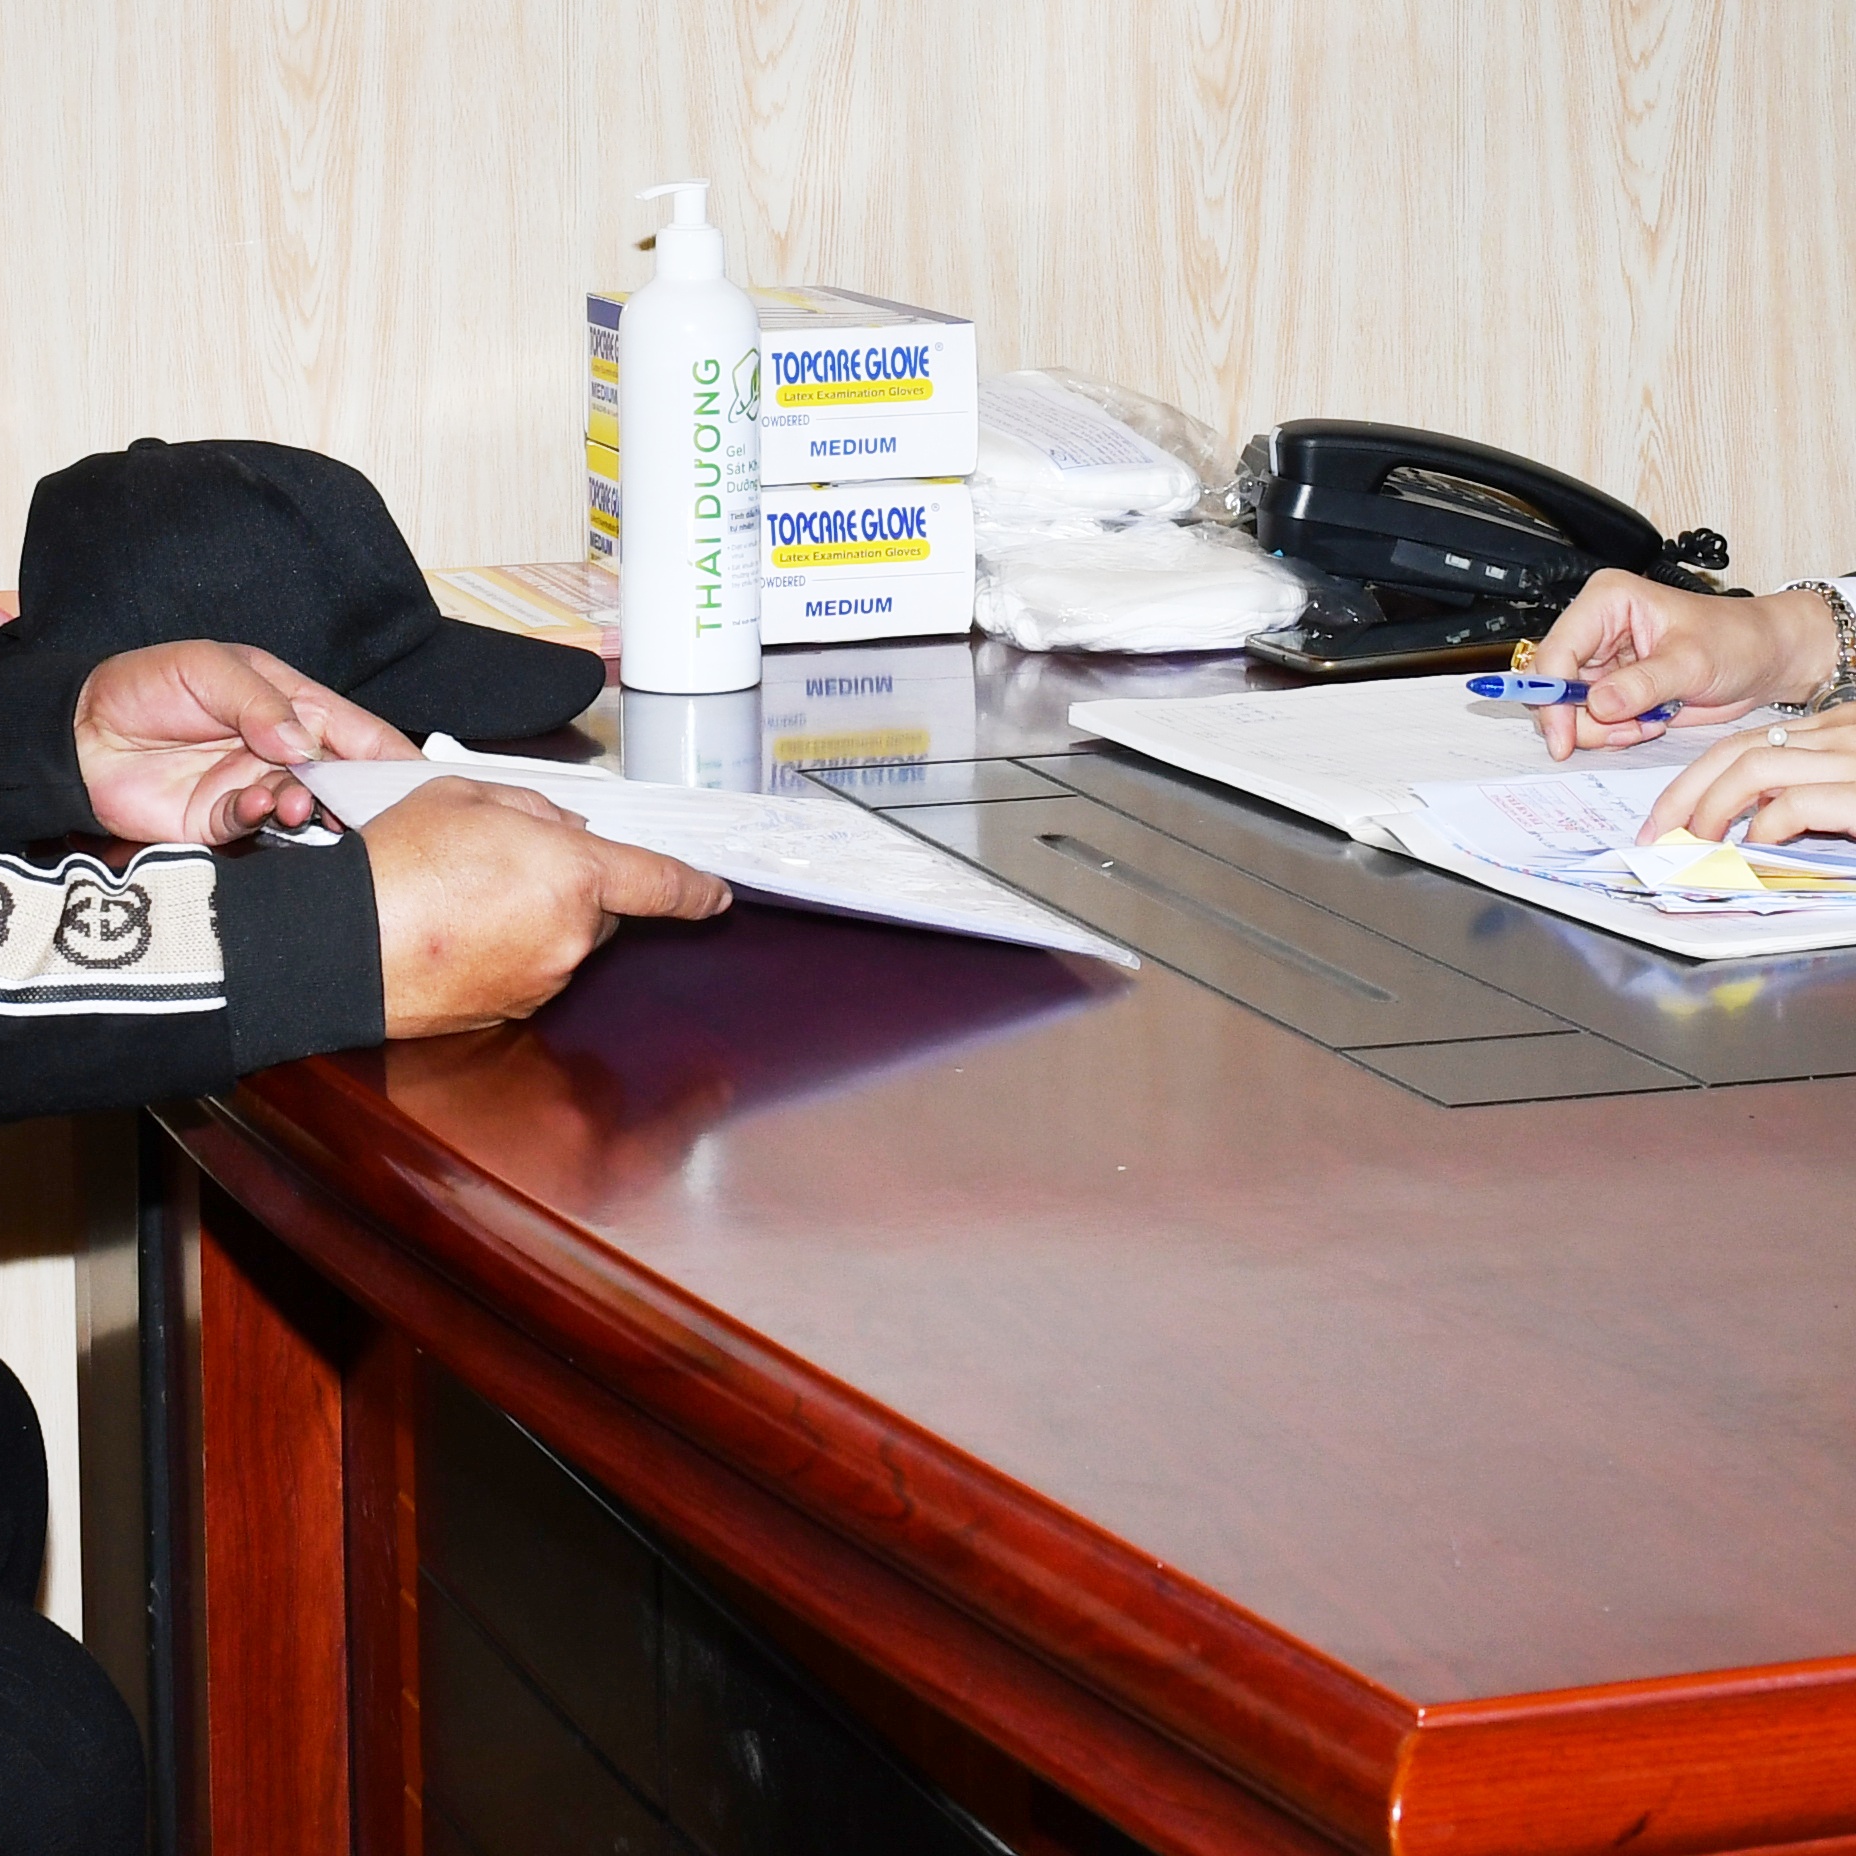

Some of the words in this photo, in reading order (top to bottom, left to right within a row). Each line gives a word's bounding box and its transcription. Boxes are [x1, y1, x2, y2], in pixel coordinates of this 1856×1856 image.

[771, 348, 862, 386] TOPCARE
[865, 345, 930, 381] GLOVE
[784, 391, 814, 402] Latex
[817, 387, 885, 400] Examination
[889, 386, 924, 397] Gloves
[693, 358, 722, 519] DƯƠNG
[810, 437, 897, 457] MEDIUM
[726, 444, 746, 457] Gel
[726, 461, 745, 475] Sát
[767, 509, 858, 547] TOPCARE
[861, 506, 927, 542] GLOVE
[779, 551, 810, 563] Latex
[813, 549, 882, 561] Examination
[885, 547, 921, 558] Gloves
[687, 537, 722, 638] THÁI
[805, 597, 893, 618] MEDIUM
